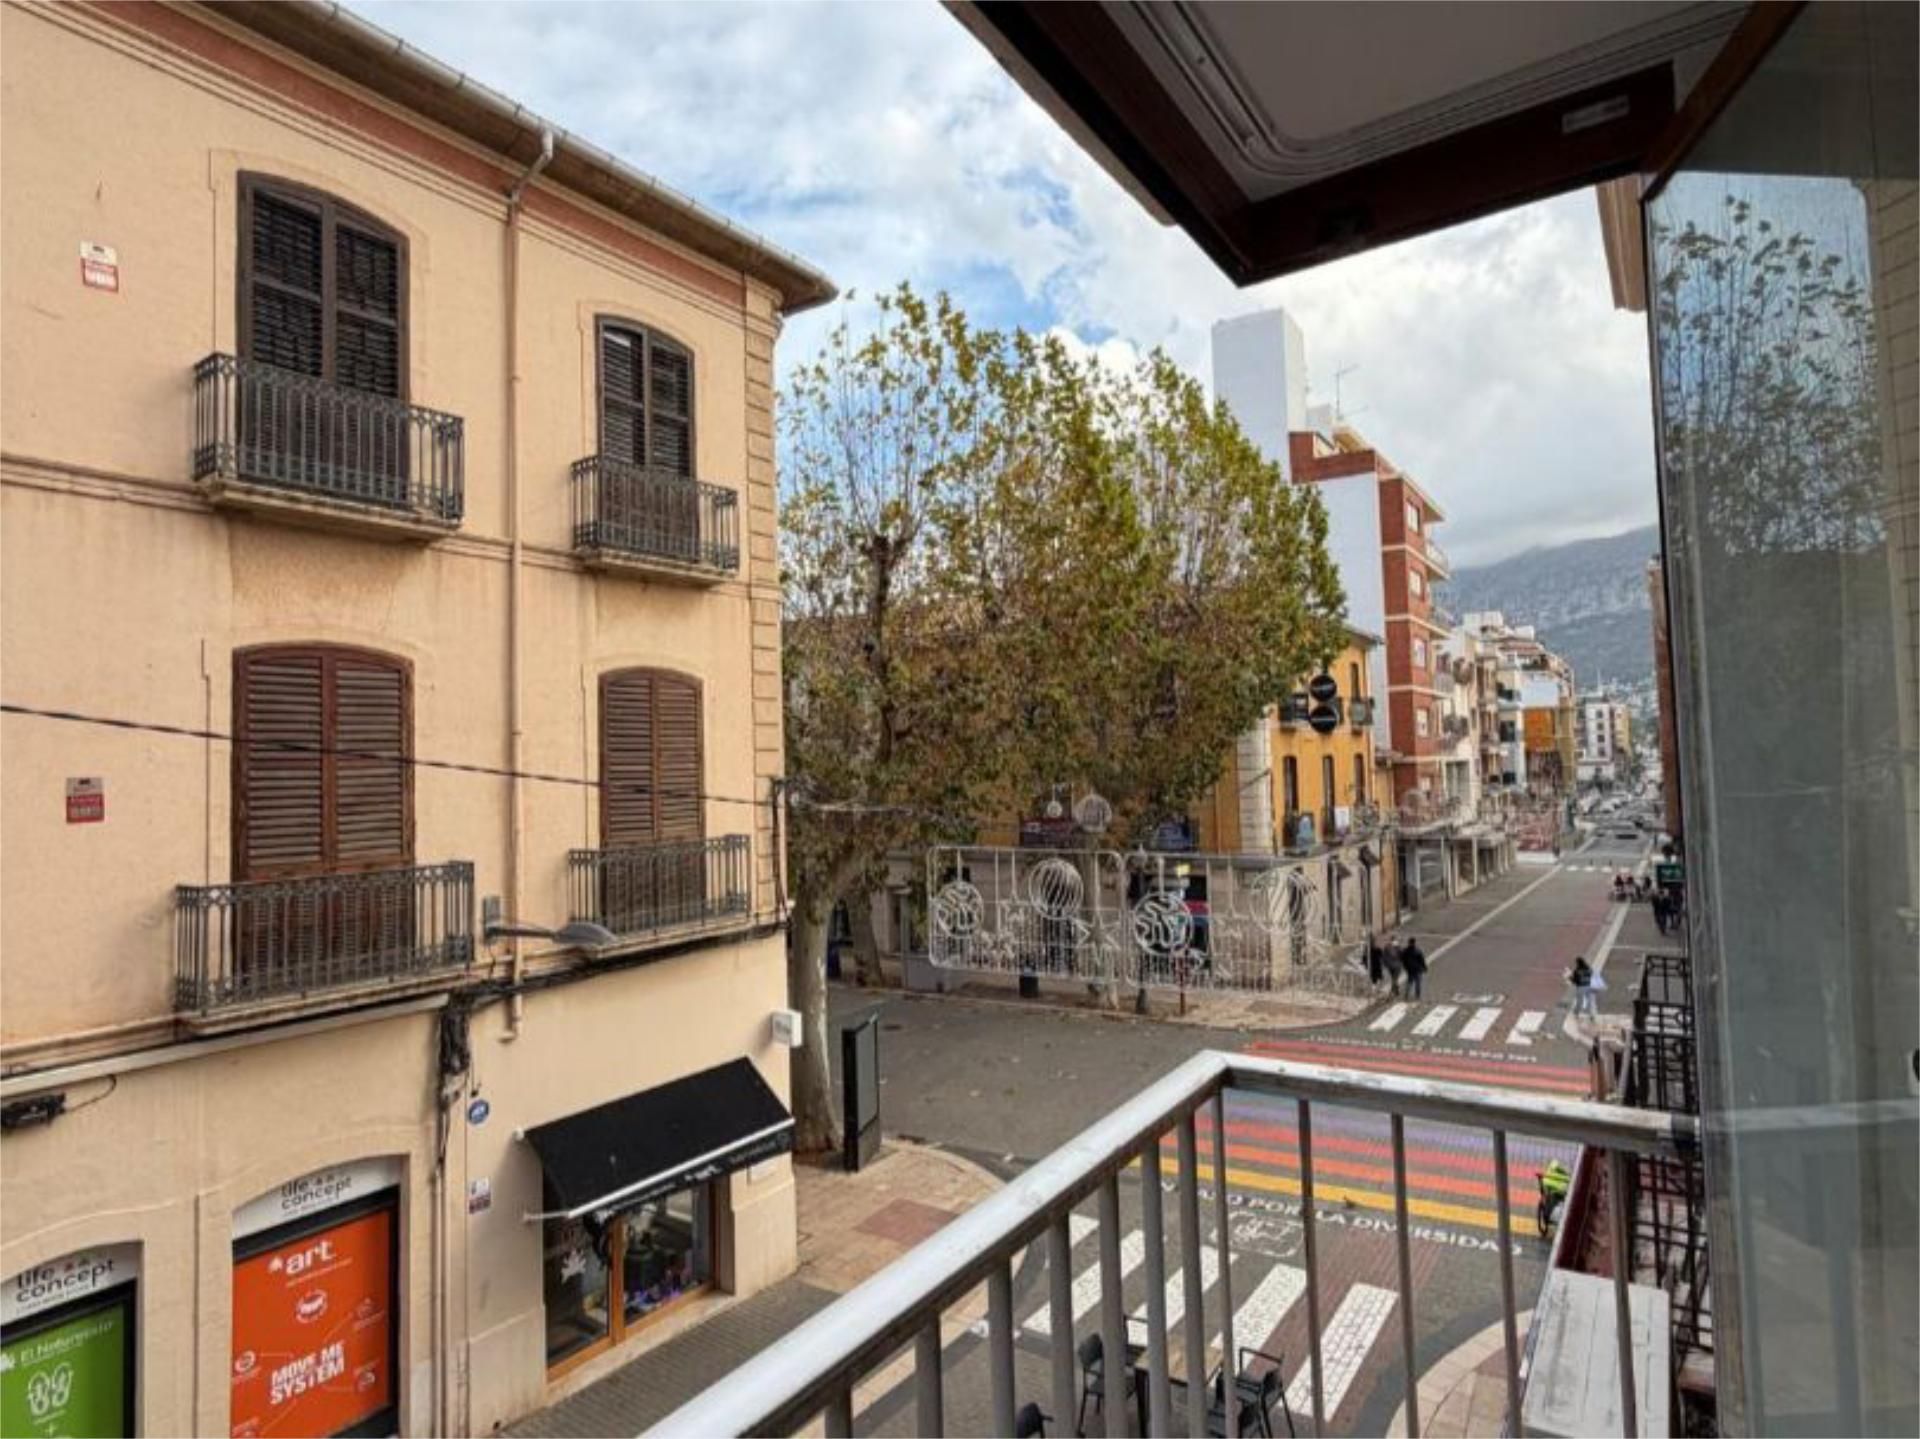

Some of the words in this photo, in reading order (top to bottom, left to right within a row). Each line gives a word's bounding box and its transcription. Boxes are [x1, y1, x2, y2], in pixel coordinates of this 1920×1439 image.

[281, 1177, 352, 1210] concept
[1248, 1198, 1302, 1216] POR
[1315, 1209, 1347, 1226] LA
[1351, 1217, 1523, 1256] DIVRSIDAD
[286, 1240, 336, 1275] art
[16, 1258, 114, 1302] concept
[17, 1265, 55, 1289] life
[270, 1359, 345, 1405] SYSTEM
[271, 1353, 316, 1389] MOVE
